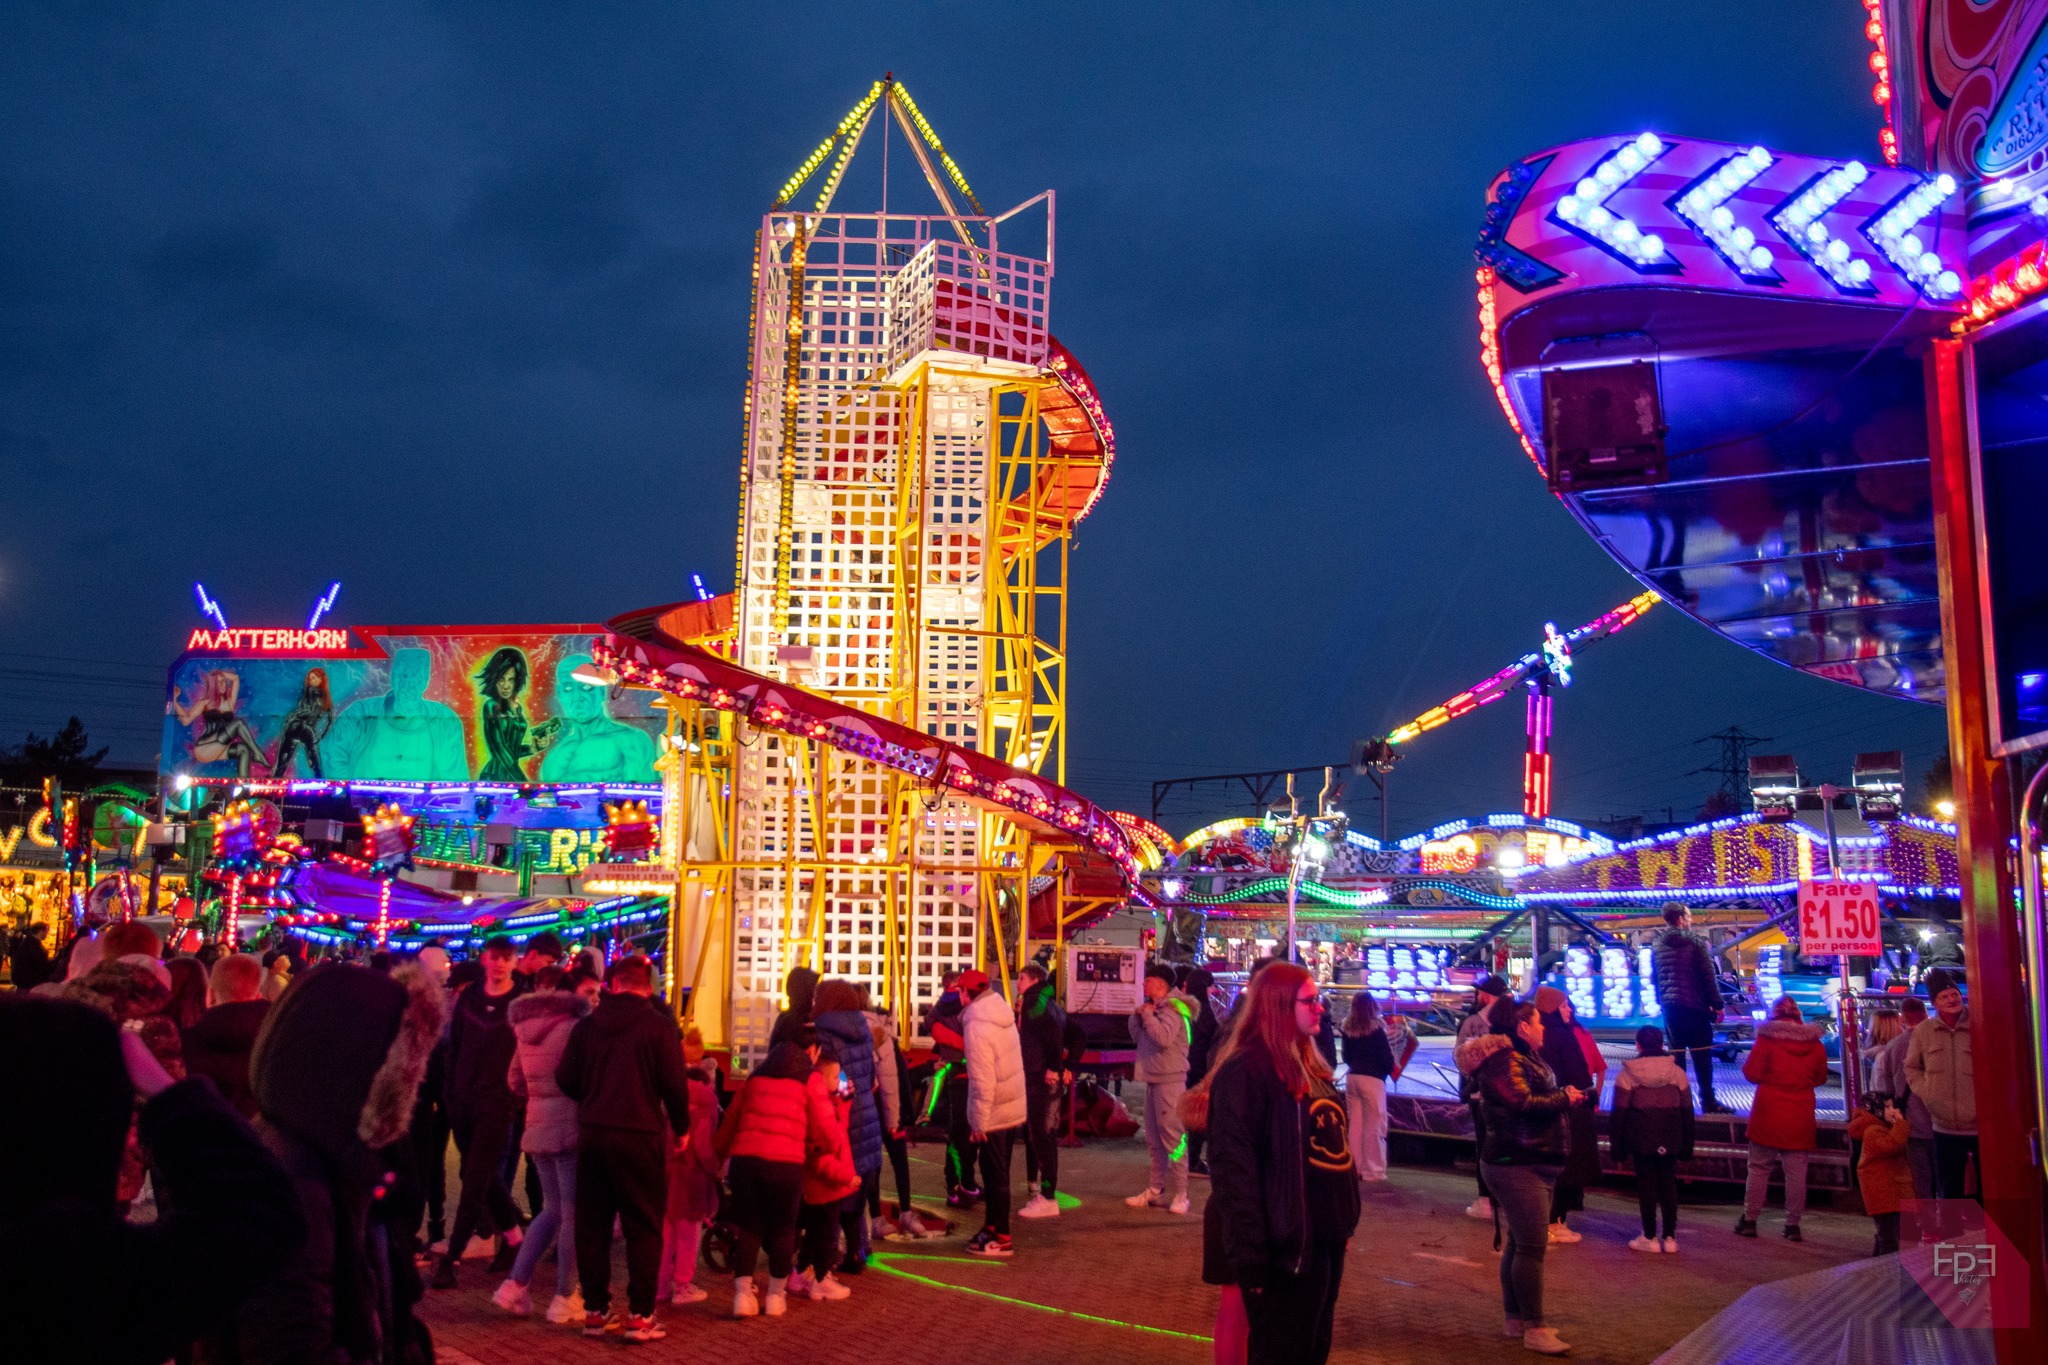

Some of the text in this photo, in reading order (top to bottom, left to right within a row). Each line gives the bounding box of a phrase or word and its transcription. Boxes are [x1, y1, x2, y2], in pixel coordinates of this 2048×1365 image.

[187, 629, 347, 649] MATTERHORN
[643, 873, 659, 881] AND
[1812, 883, 1863, 897] Fare
[1803, 899, 1876, 939] £1.50
[1806, 941, 1877, 952] per person
